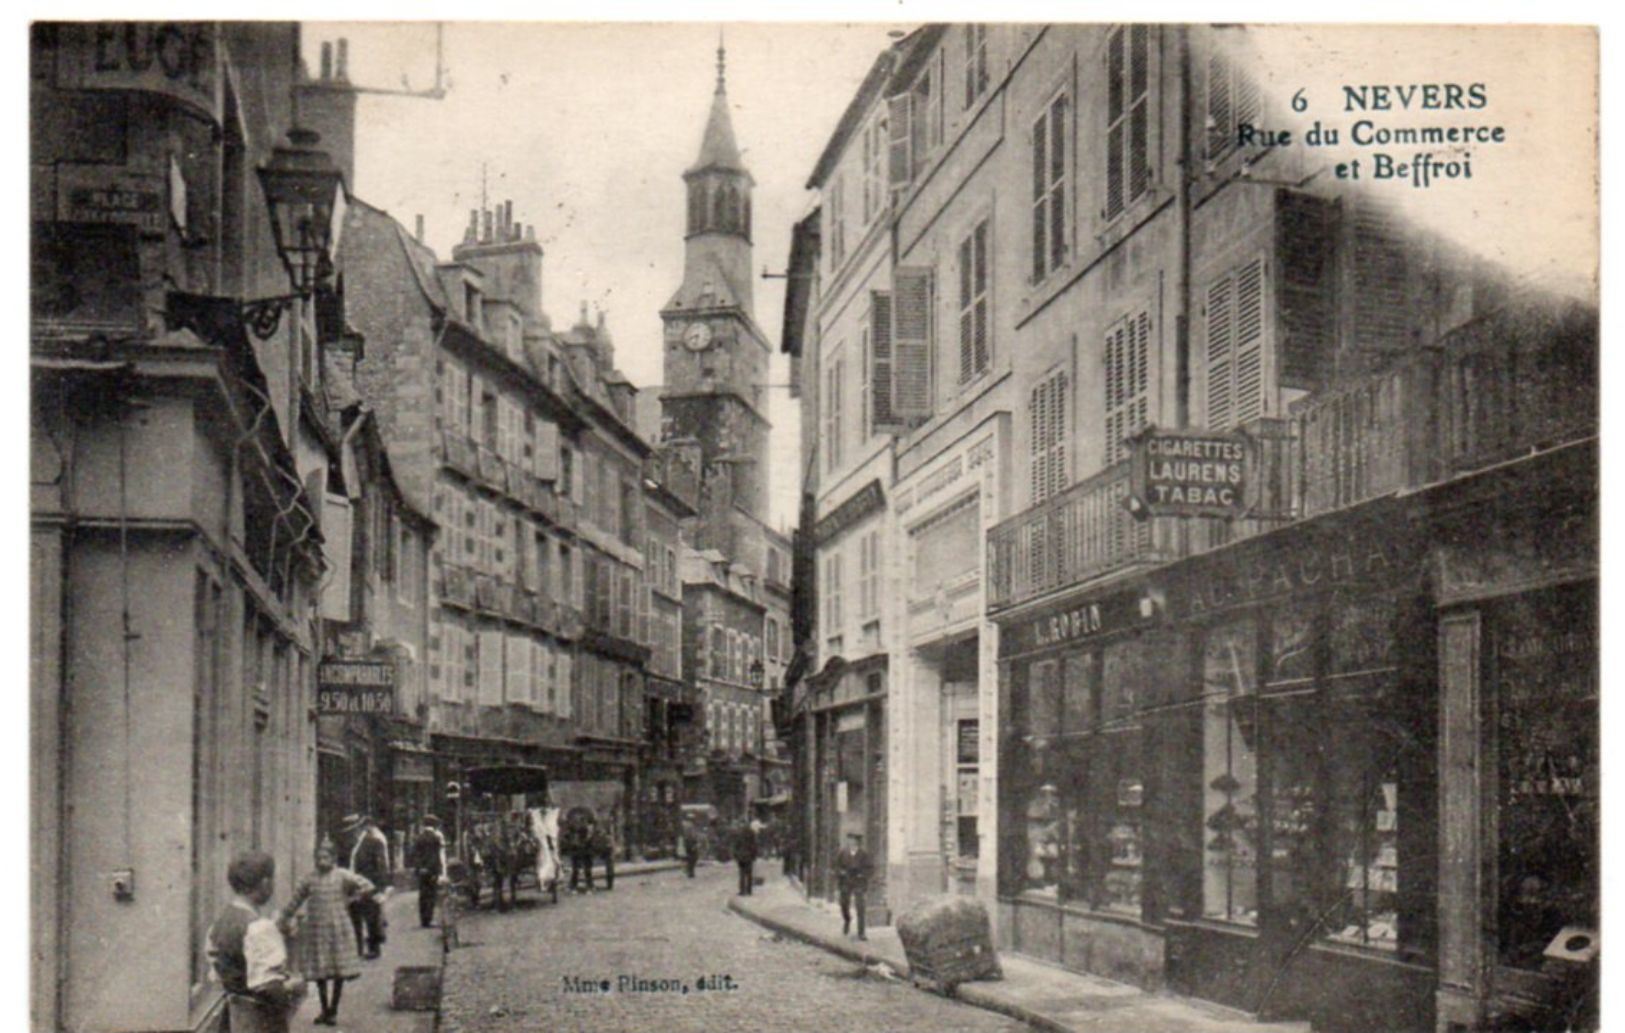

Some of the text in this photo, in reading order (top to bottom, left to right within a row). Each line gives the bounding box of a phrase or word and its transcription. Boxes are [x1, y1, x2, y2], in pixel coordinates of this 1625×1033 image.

[1148, 439, 1243, 460] CIGARETTES
[1149, 460, 1241, 485] LAURENS
[1154, 484, 1233, 505] TABAC
[1247, 536, 1390, 600] PACHA
